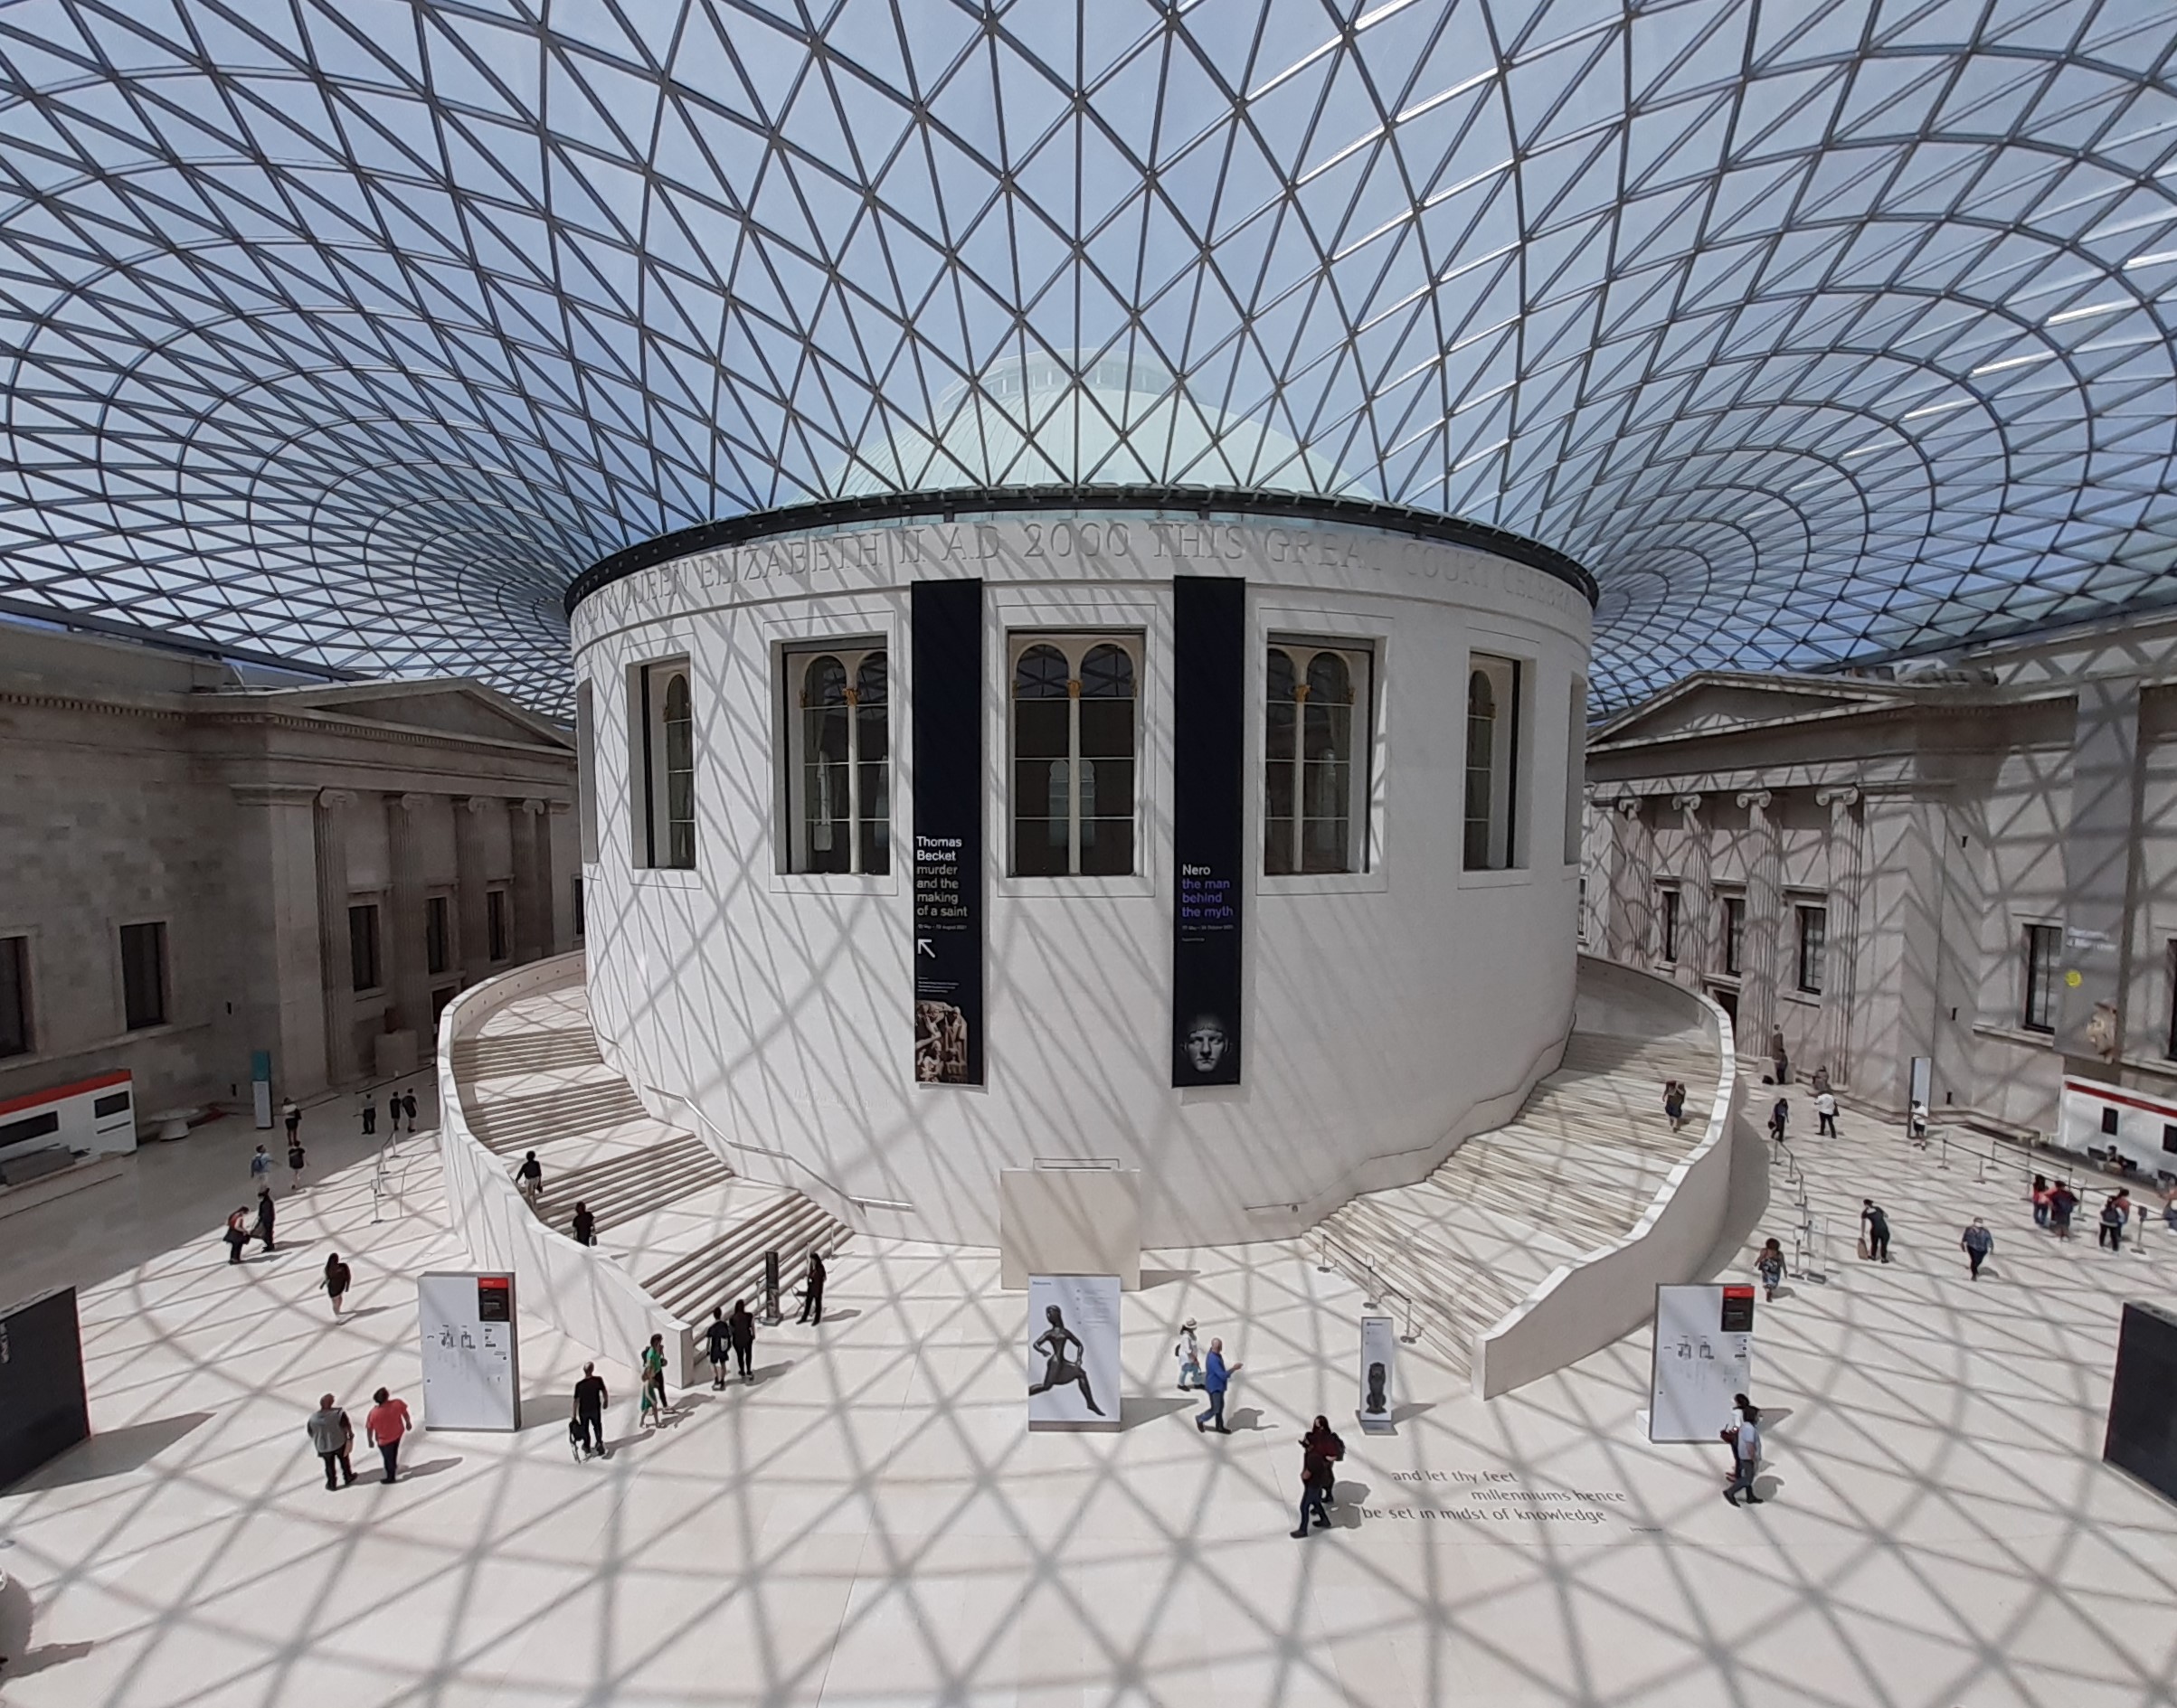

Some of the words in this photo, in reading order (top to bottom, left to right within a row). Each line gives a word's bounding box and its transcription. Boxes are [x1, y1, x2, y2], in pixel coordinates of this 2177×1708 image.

[621, 561, 688, 611] QUEEN
[699, 532, 884, 589] ELIZABETH
[898, 528, 928, 564] II
[1023, 522, 1131, 559] 2000
[1149, 521, 1243, 560] THIS
[1264, 527, 1388, 571] GREAT
[1402, 542, 1495, 589] COURT
[915, 835, 962, 847] Thomas
[916, 850, 956, 861] Becket
[916, 863, 958, 875] murder
[1182, 863, 1211, 876] Nero
[916, 878, 938, 889] and
[941, 878, 959, 889] the
[1181, 878, 1202, 890] the
[1205, 881, 1230, 889] man
[917, 892, 959, 904] making
[1182, 892, 1223, 903] behind
[917, 905, 929, 916] of
[931, 908, 938, 916] a
[941, 906, 968, 917] saint
[1181, 906, 1201, 918] the
[1204, 905, 1234, 920] myth
[1393, 1469, 1423, 1482] and
[1425, 1469, 1448, 1482] let
[1451, 1470, 1477, 1484] thy
[1482, 1470, 1519, 1483] feet
[1471, 1488, 1571, 1502] millenniums
[1572, 1490, 1627, 1503] hence
[1361, 1505, 1383, 1519] be
[1388, 1508, 1415, 1519] set
[1419, 1509, 1436, 1519] in
[1440, 1507, 1489, 1521] midst
[1492, 1508, 1510, 1521] of
[1513, 1507, 1607, 1524] knowledge
